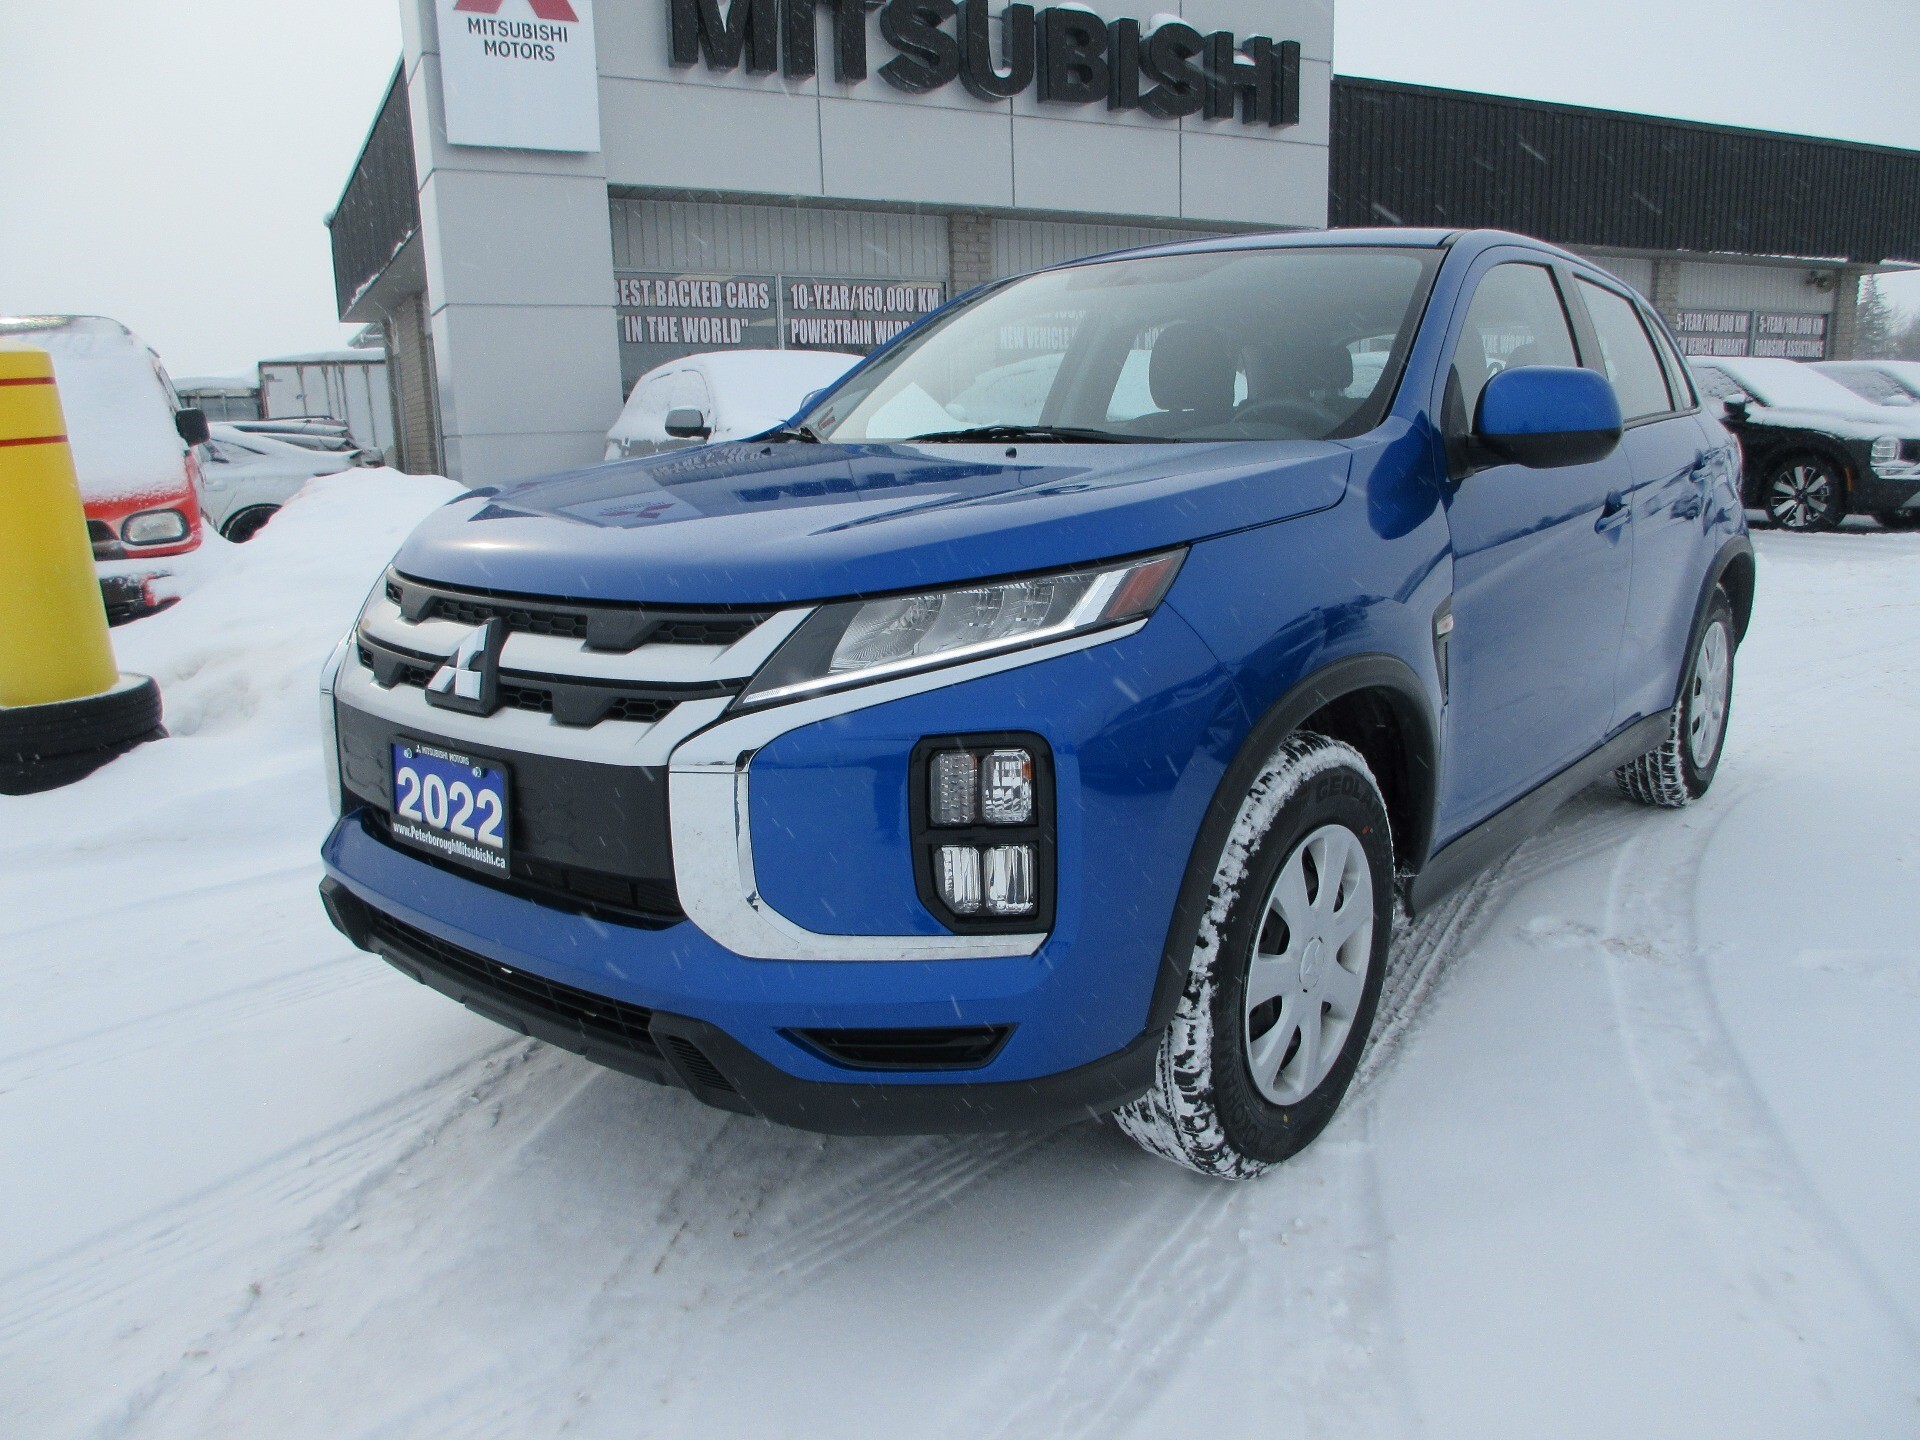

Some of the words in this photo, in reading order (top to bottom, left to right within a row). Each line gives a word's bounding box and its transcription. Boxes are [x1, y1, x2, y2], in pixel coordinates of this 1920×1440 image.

[467, 17, 568, 43] MITSUBISHI
[484, 39, 556, 62] MOTORS
[668, 0, 1300, 127] MITSUBISHI
[655, 280, 722, 308] BACKED
[726, 282, 770, 310] CARS
[790, 284, 914, 313] 10-YEAR/160,000
[917, 288, 939, 312] KM
[624, 316, 643, 343] IN
[647, 316, 679, 344] THE
[790, 318, 872, 344] POWERTRAIN
[421, 746, 448, 760] MITSUBISHI
[397, 766, 503, 848] 2022
[393, 822, 506, 869] www.PeterboroughMitsubishi.ca
